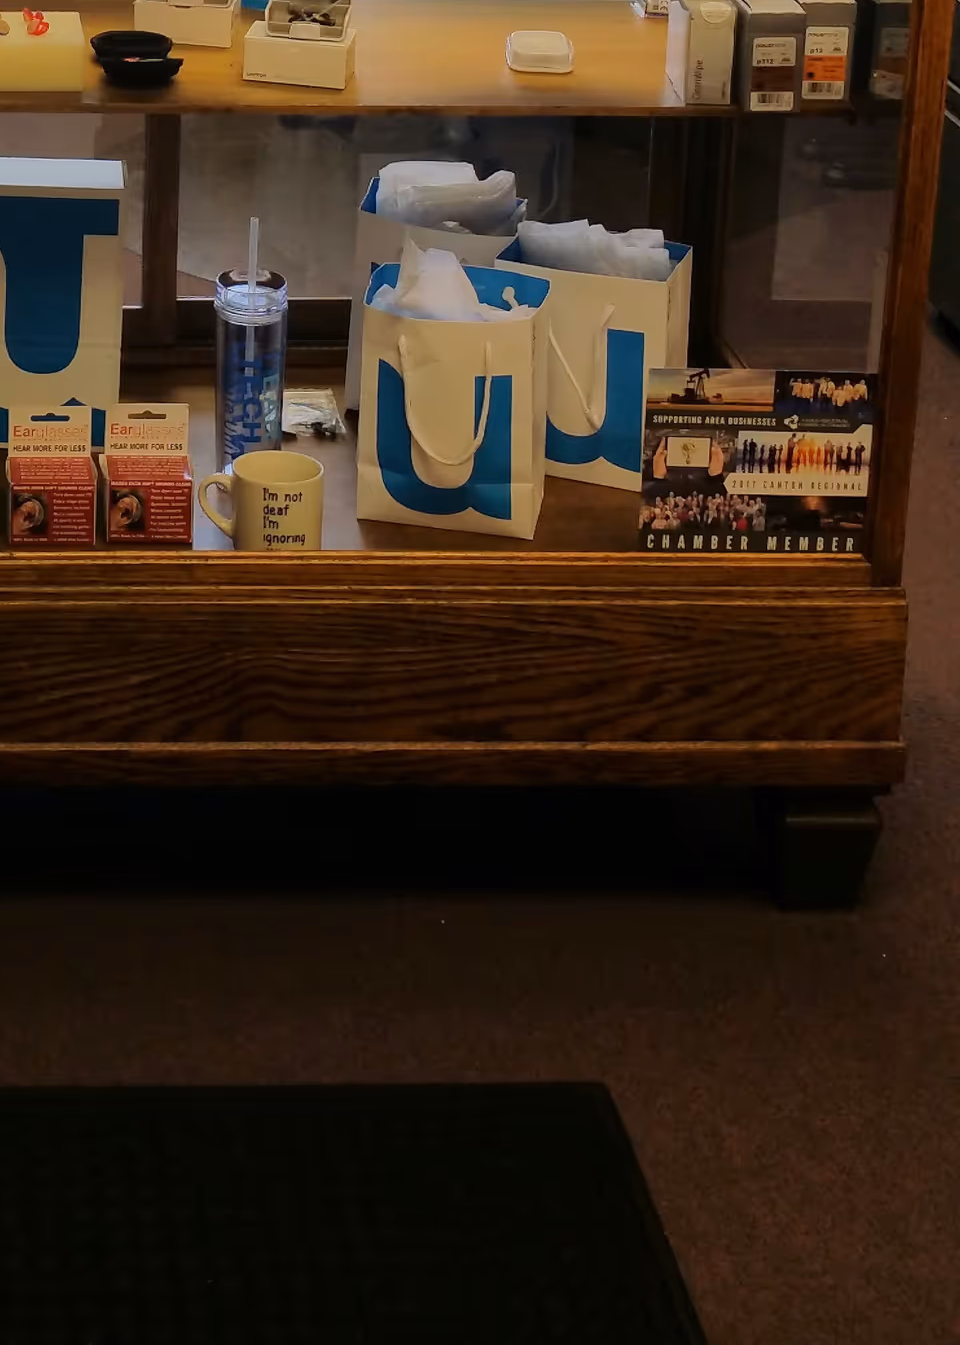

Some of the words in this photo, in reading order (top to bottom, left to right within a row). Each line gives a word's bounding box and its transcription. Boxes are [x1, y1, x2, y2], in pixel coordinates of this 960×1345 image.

[653, 415, 702, 424] SUPPORTING
[705, 416, 726, 424] AREA
[728, 417, 776, 426] BUSINESSES
[166, 443, 183, 451] LESS
[763, 481, 803, 490] CANTON
[811, 482, 862, 491] REGIONAL
[262, 487, 279, 501] I'm
[284, 492, 303, 502] not
[263, 504, 289, 516] deaf
[263, 516, 279, 529] I'm
[263, 534, 305, 546] ignoring
[647, 533, 749, 550] CHAMBER
[766, 536, 855, 552] MEMBER
